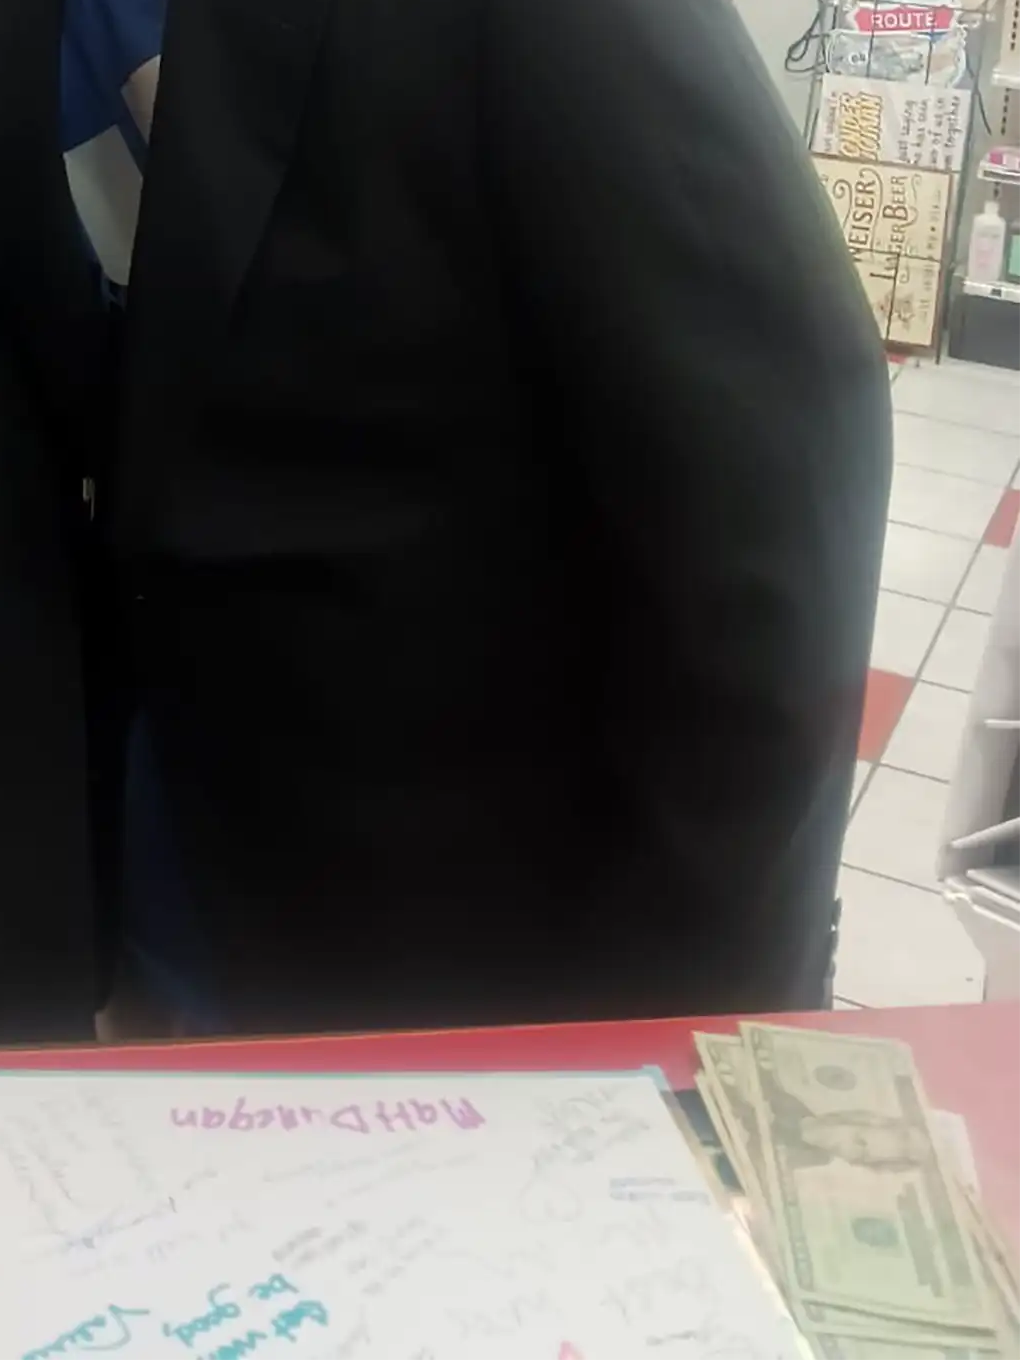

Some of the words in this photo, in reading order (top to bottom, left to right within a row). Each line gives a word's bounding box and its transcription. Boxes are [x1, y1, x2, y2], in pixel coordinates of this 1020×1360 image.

[871, 11, 937, 29] ROUTE
[838, 91, 860, 158] ONDER
[881, 176, 908, 222] BEER
